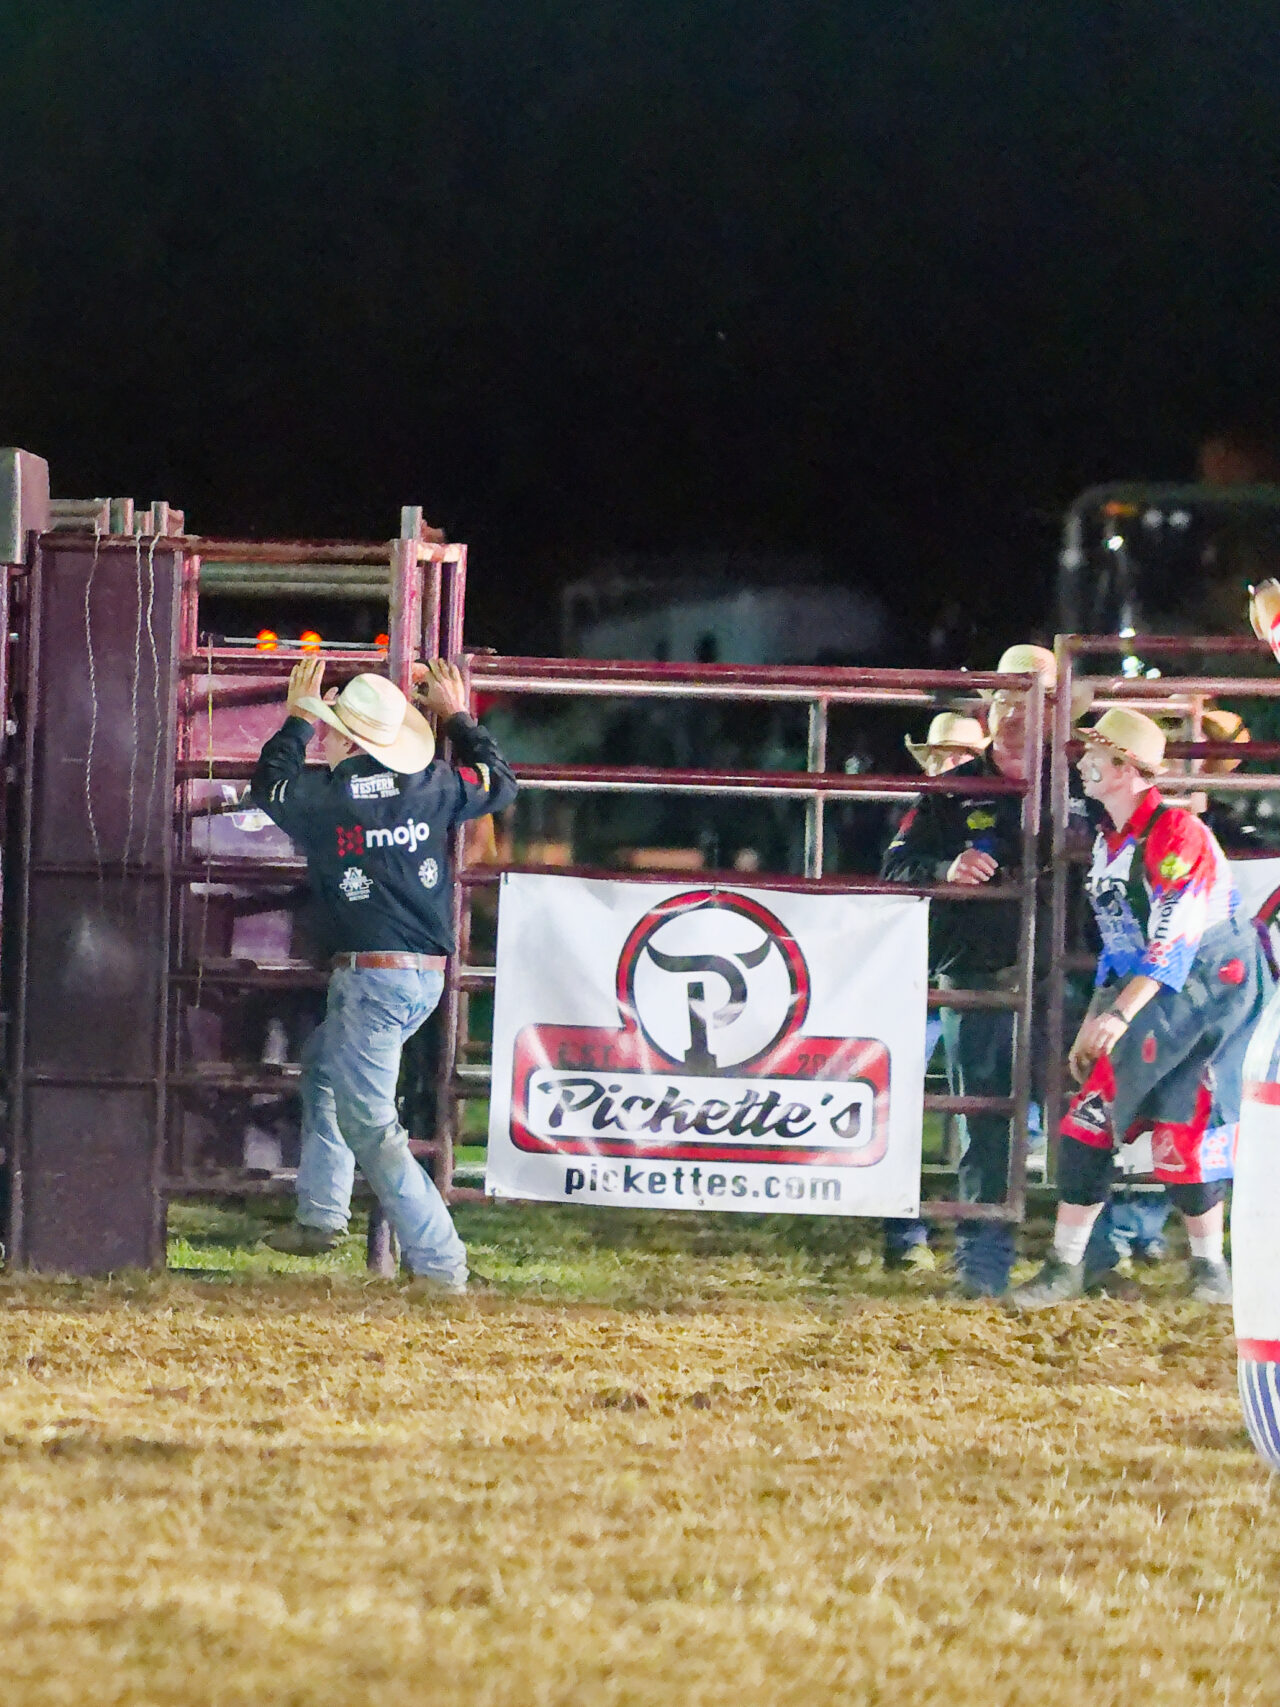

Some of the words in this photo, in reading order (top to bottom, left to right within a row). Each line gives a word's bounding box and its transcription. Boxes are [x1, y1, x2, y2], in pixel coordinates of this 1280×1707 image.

[365, 818, 430, 853] mojo
[536, 1078, 863, 1139] Pickette's
[565, 1164, 842, 1202] pickettes.com
